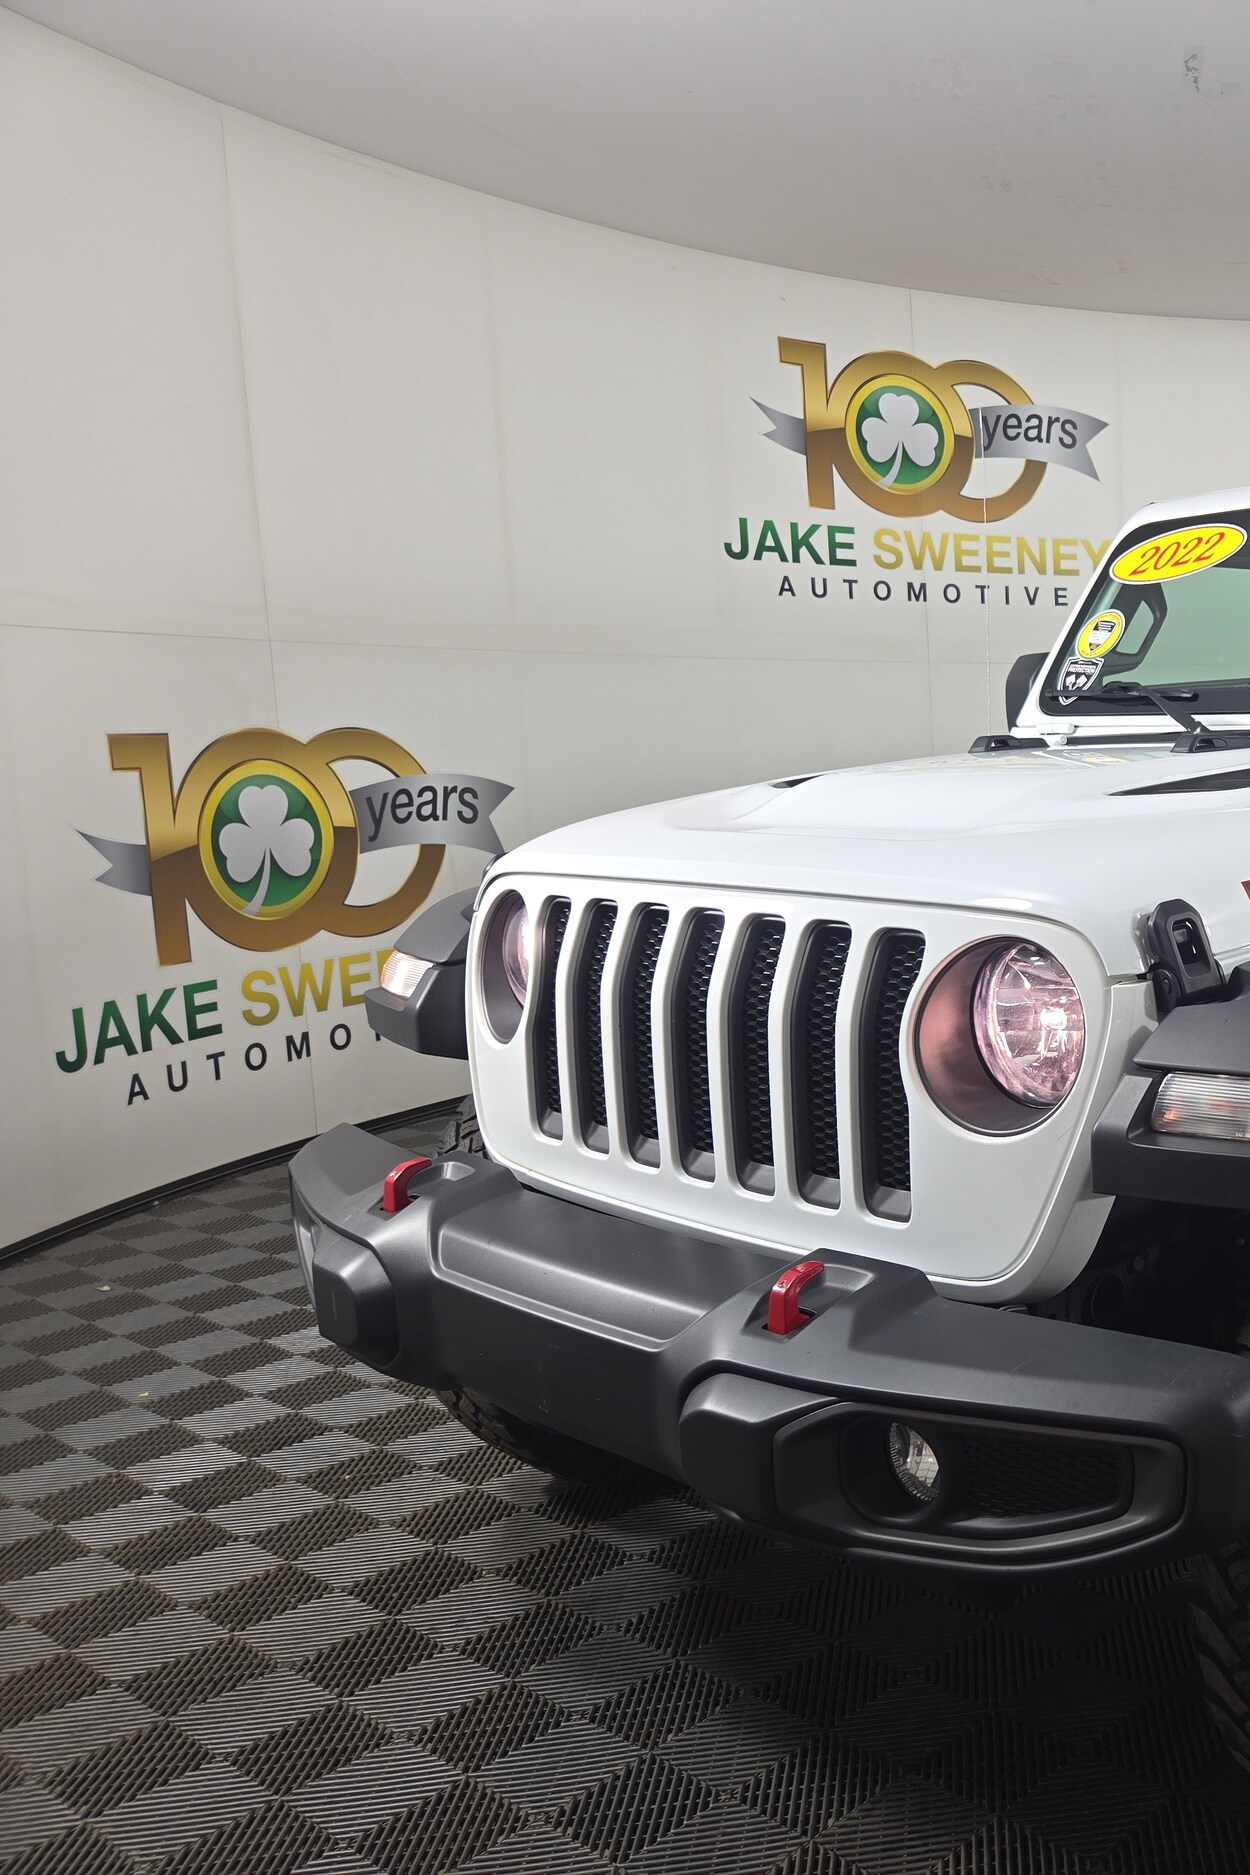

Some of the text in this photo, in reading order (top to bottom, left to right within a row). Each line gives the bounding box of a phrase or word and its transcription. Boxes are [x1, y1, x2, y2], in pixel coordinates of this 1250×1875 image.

[981, 412, 1079, 452] years
[723, 516, 858, 567] JAKE
[1128, 531, 1226, 577] 2022
[778, 575, 1069, 606] AUTOMOTIVE
[365, 782, 480, 842] years
[55, 979, 223, 1073] JAKE
[126, 1022, 382, 1106] AUTOMO
